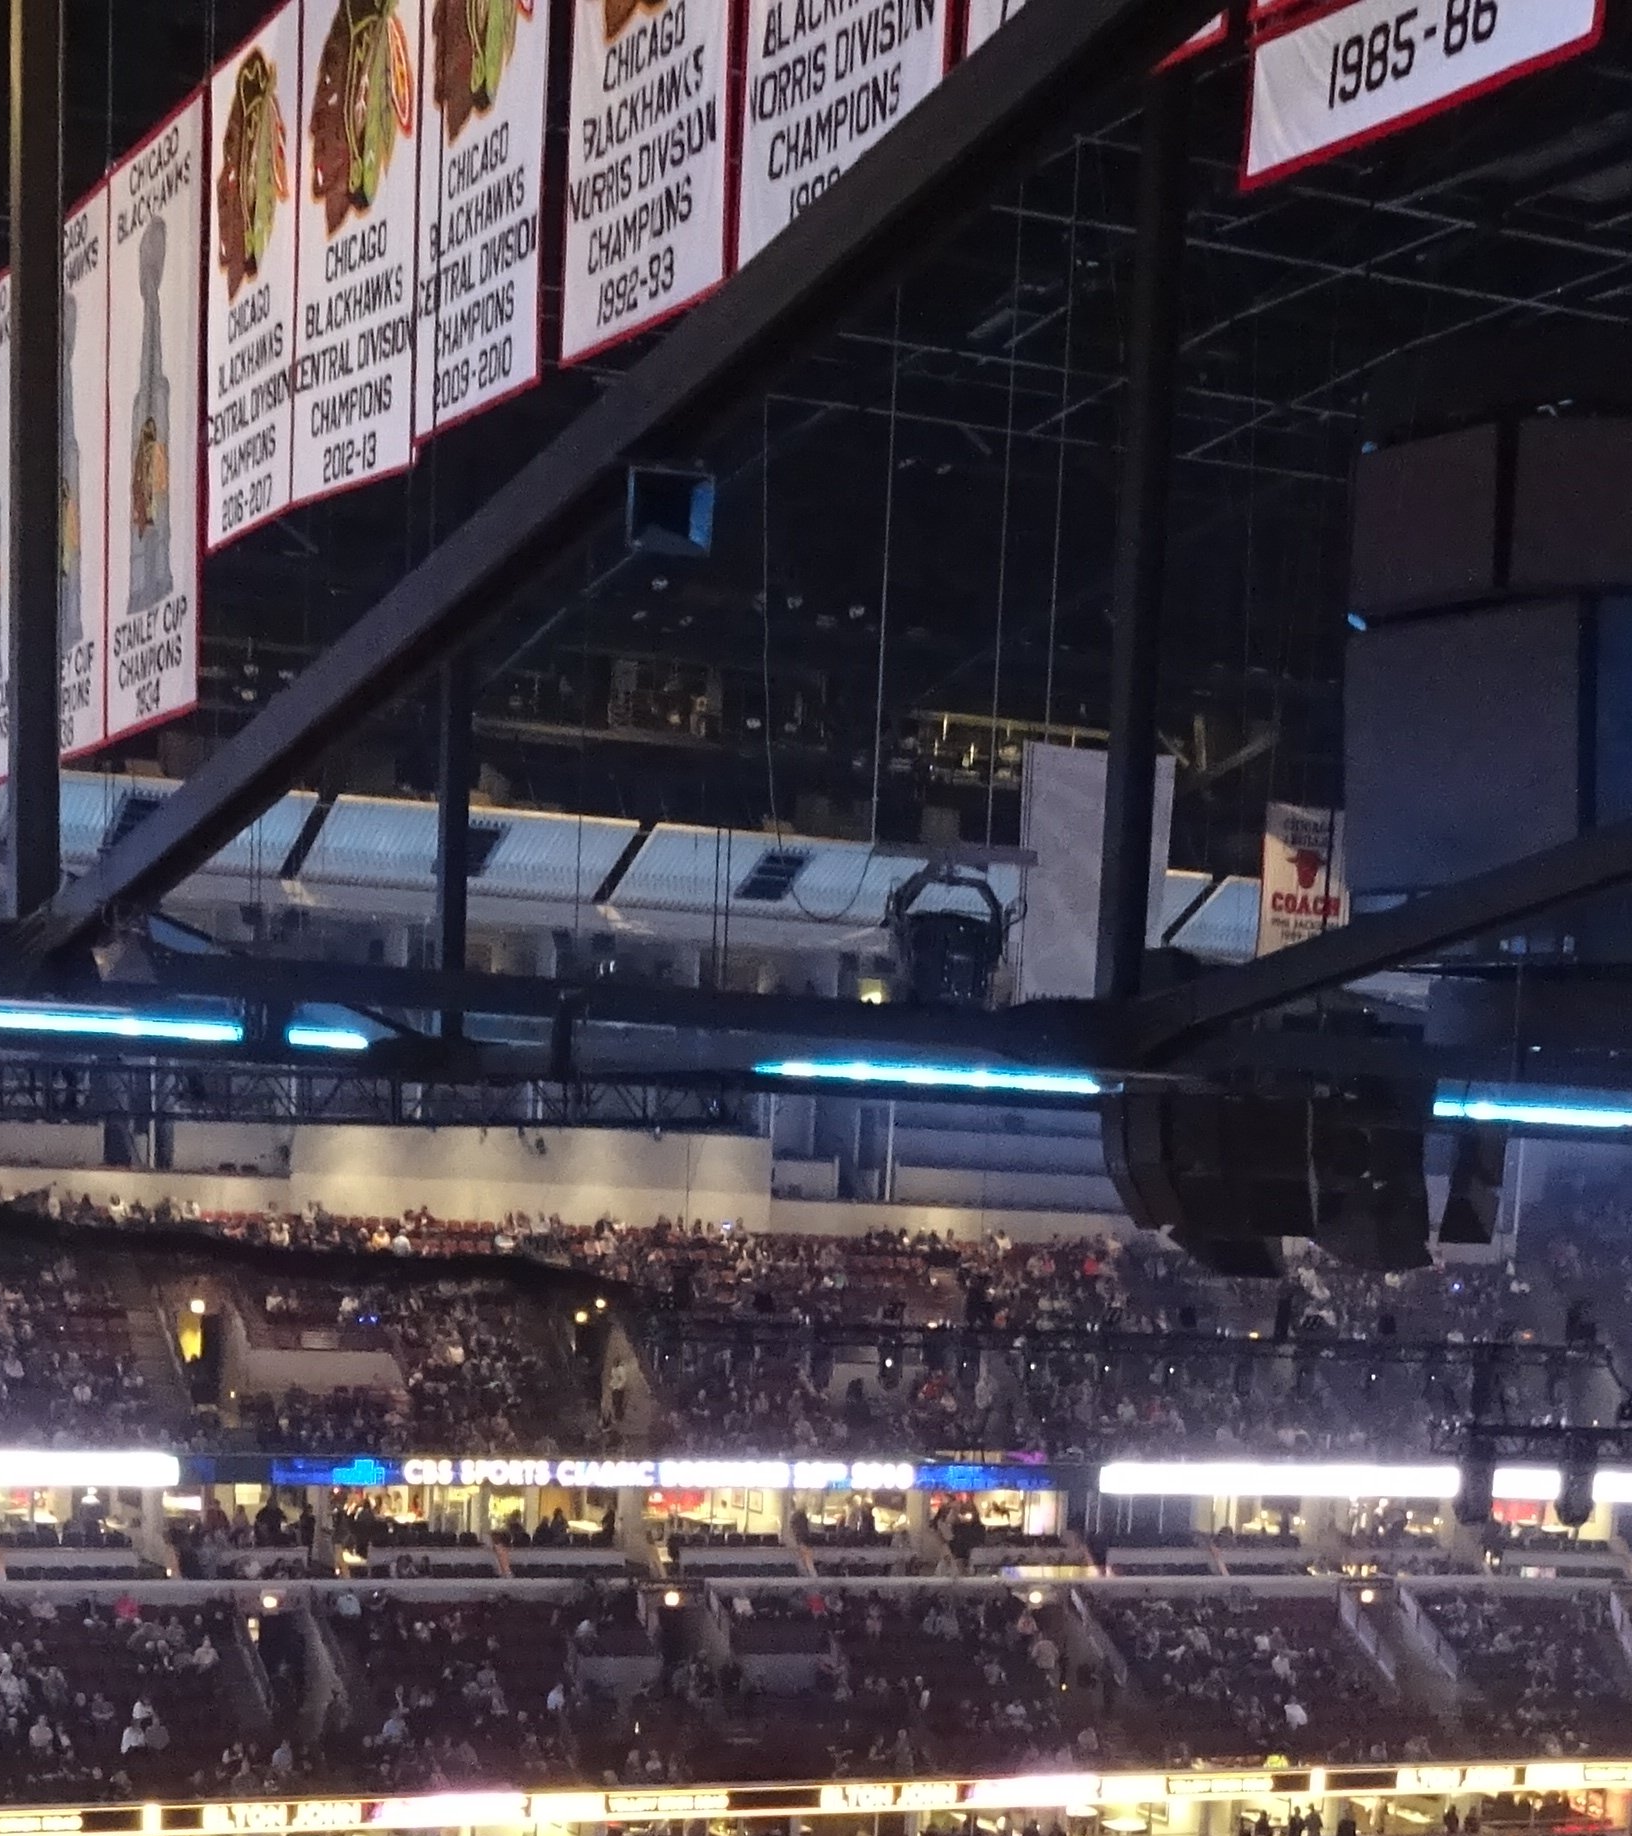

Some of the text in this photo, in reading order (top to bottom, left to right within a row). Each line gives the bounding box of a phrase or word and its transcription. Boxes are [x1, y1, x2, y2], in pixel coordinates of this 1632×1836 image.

[603, 1, 686, 92] CHICAGO
[750, 0, 934, 128] NORRIS DIVISION
[1327, 0, 1498, 110] 1985-86
[583, 44, 704, 163] BLACKHAWKS
[769, 61, 902, 180] CHAMPIONS
[117, 150, 191, 245] BLACKHAWKS
[129, 126, 179, 196] CHICAGO
[448, 121, 510, 200] CHICAGO
[569, 154, 633, 223] NORRIS
[325, 219, 388, 282] CHICAGO
[587, 175, 692, 276] CHAMPIONS
[227, 284, 270, 344] CHICAGO
[305, 264, 404, 340] BLACKHAWKS
[435, 280, 515, 359] CHAMPIONS
[596, 246, 675, 327] 1992-93
[218, 322, 283, 398] BLACKHAWKS
[295, 314, 415, 395] CENTRAL DIVISION
[433, 333, 513, 412] 2009-2010
[207, 362, 293, 447] CENTRAL DIVISION
[310, 373, 392, 438] CHAMPIONS
[220, 423, 276, 487] CHAMPIONS
[323, 431, 377, 483] 2012-13
[221, 473, 273, 532] 2016-2017
[113, 594, 188, 657] STANLEY CUP
[118, 634, 182, 691] CHAMPIONS
[1271, 891, 1340, 917] COACH
[403, 1458, 453, 1485] CBS
[460, 1458, 550, 1486] SPORTS
